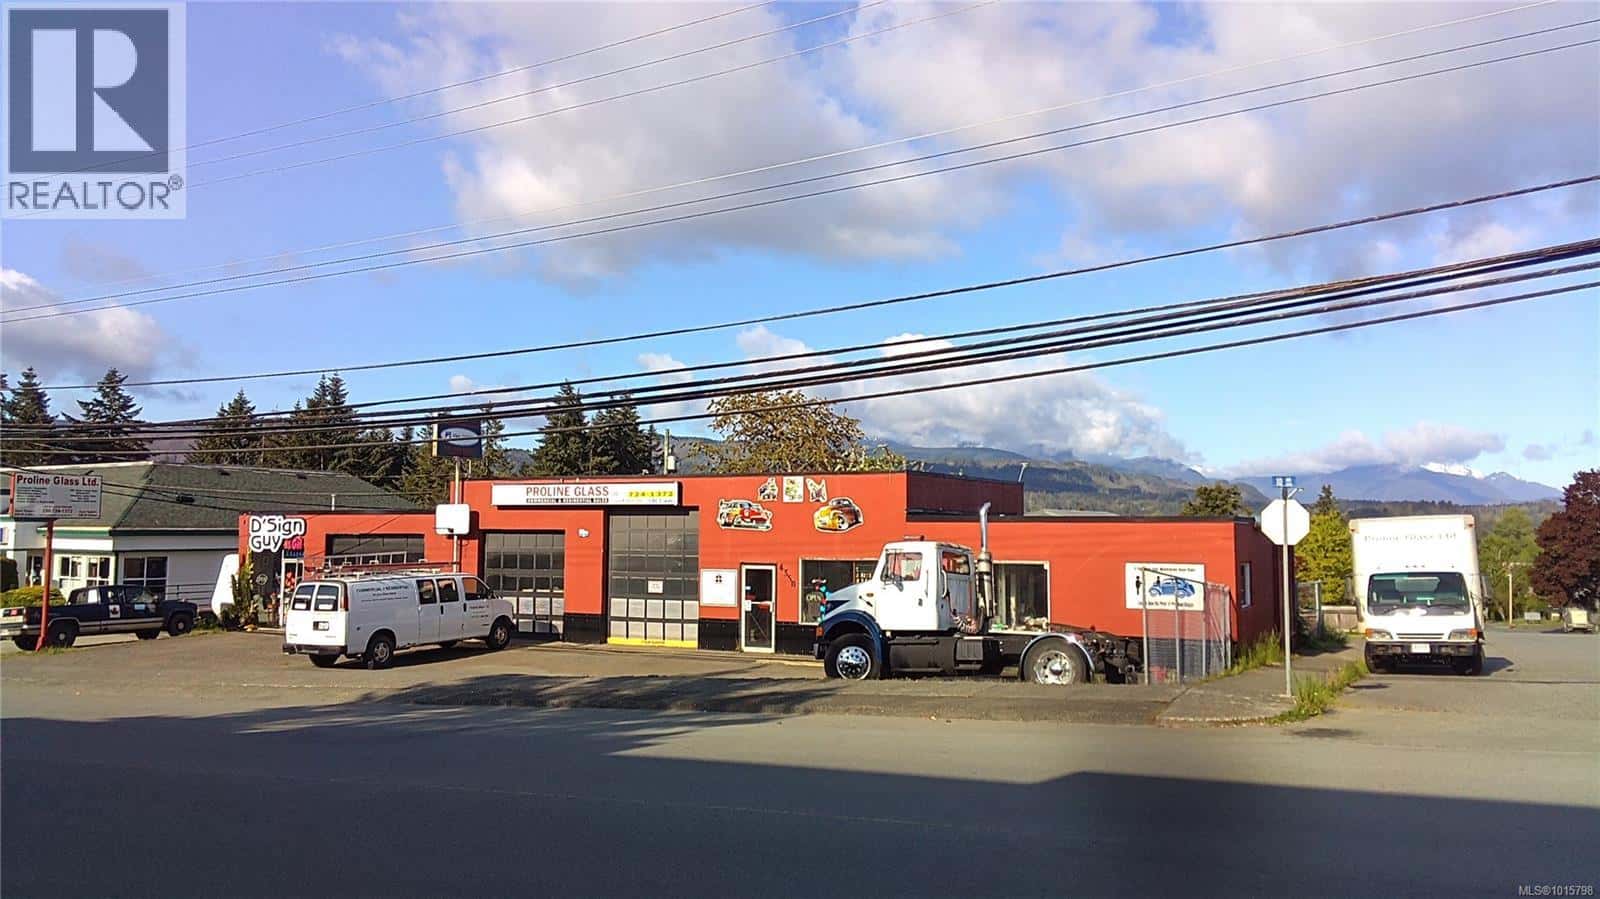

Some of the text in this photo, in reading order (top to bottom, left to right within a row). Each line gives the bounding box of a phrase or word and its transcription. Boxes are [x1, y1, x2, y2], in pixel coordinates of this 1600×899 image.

[16, 475, 99, 487] Proline Glass Ltd.
[526, 486, 609, 497] PROLINE GLASS
[251, 518, 303, 536] D'Sign
[251, 535, 281, 550] Guy
